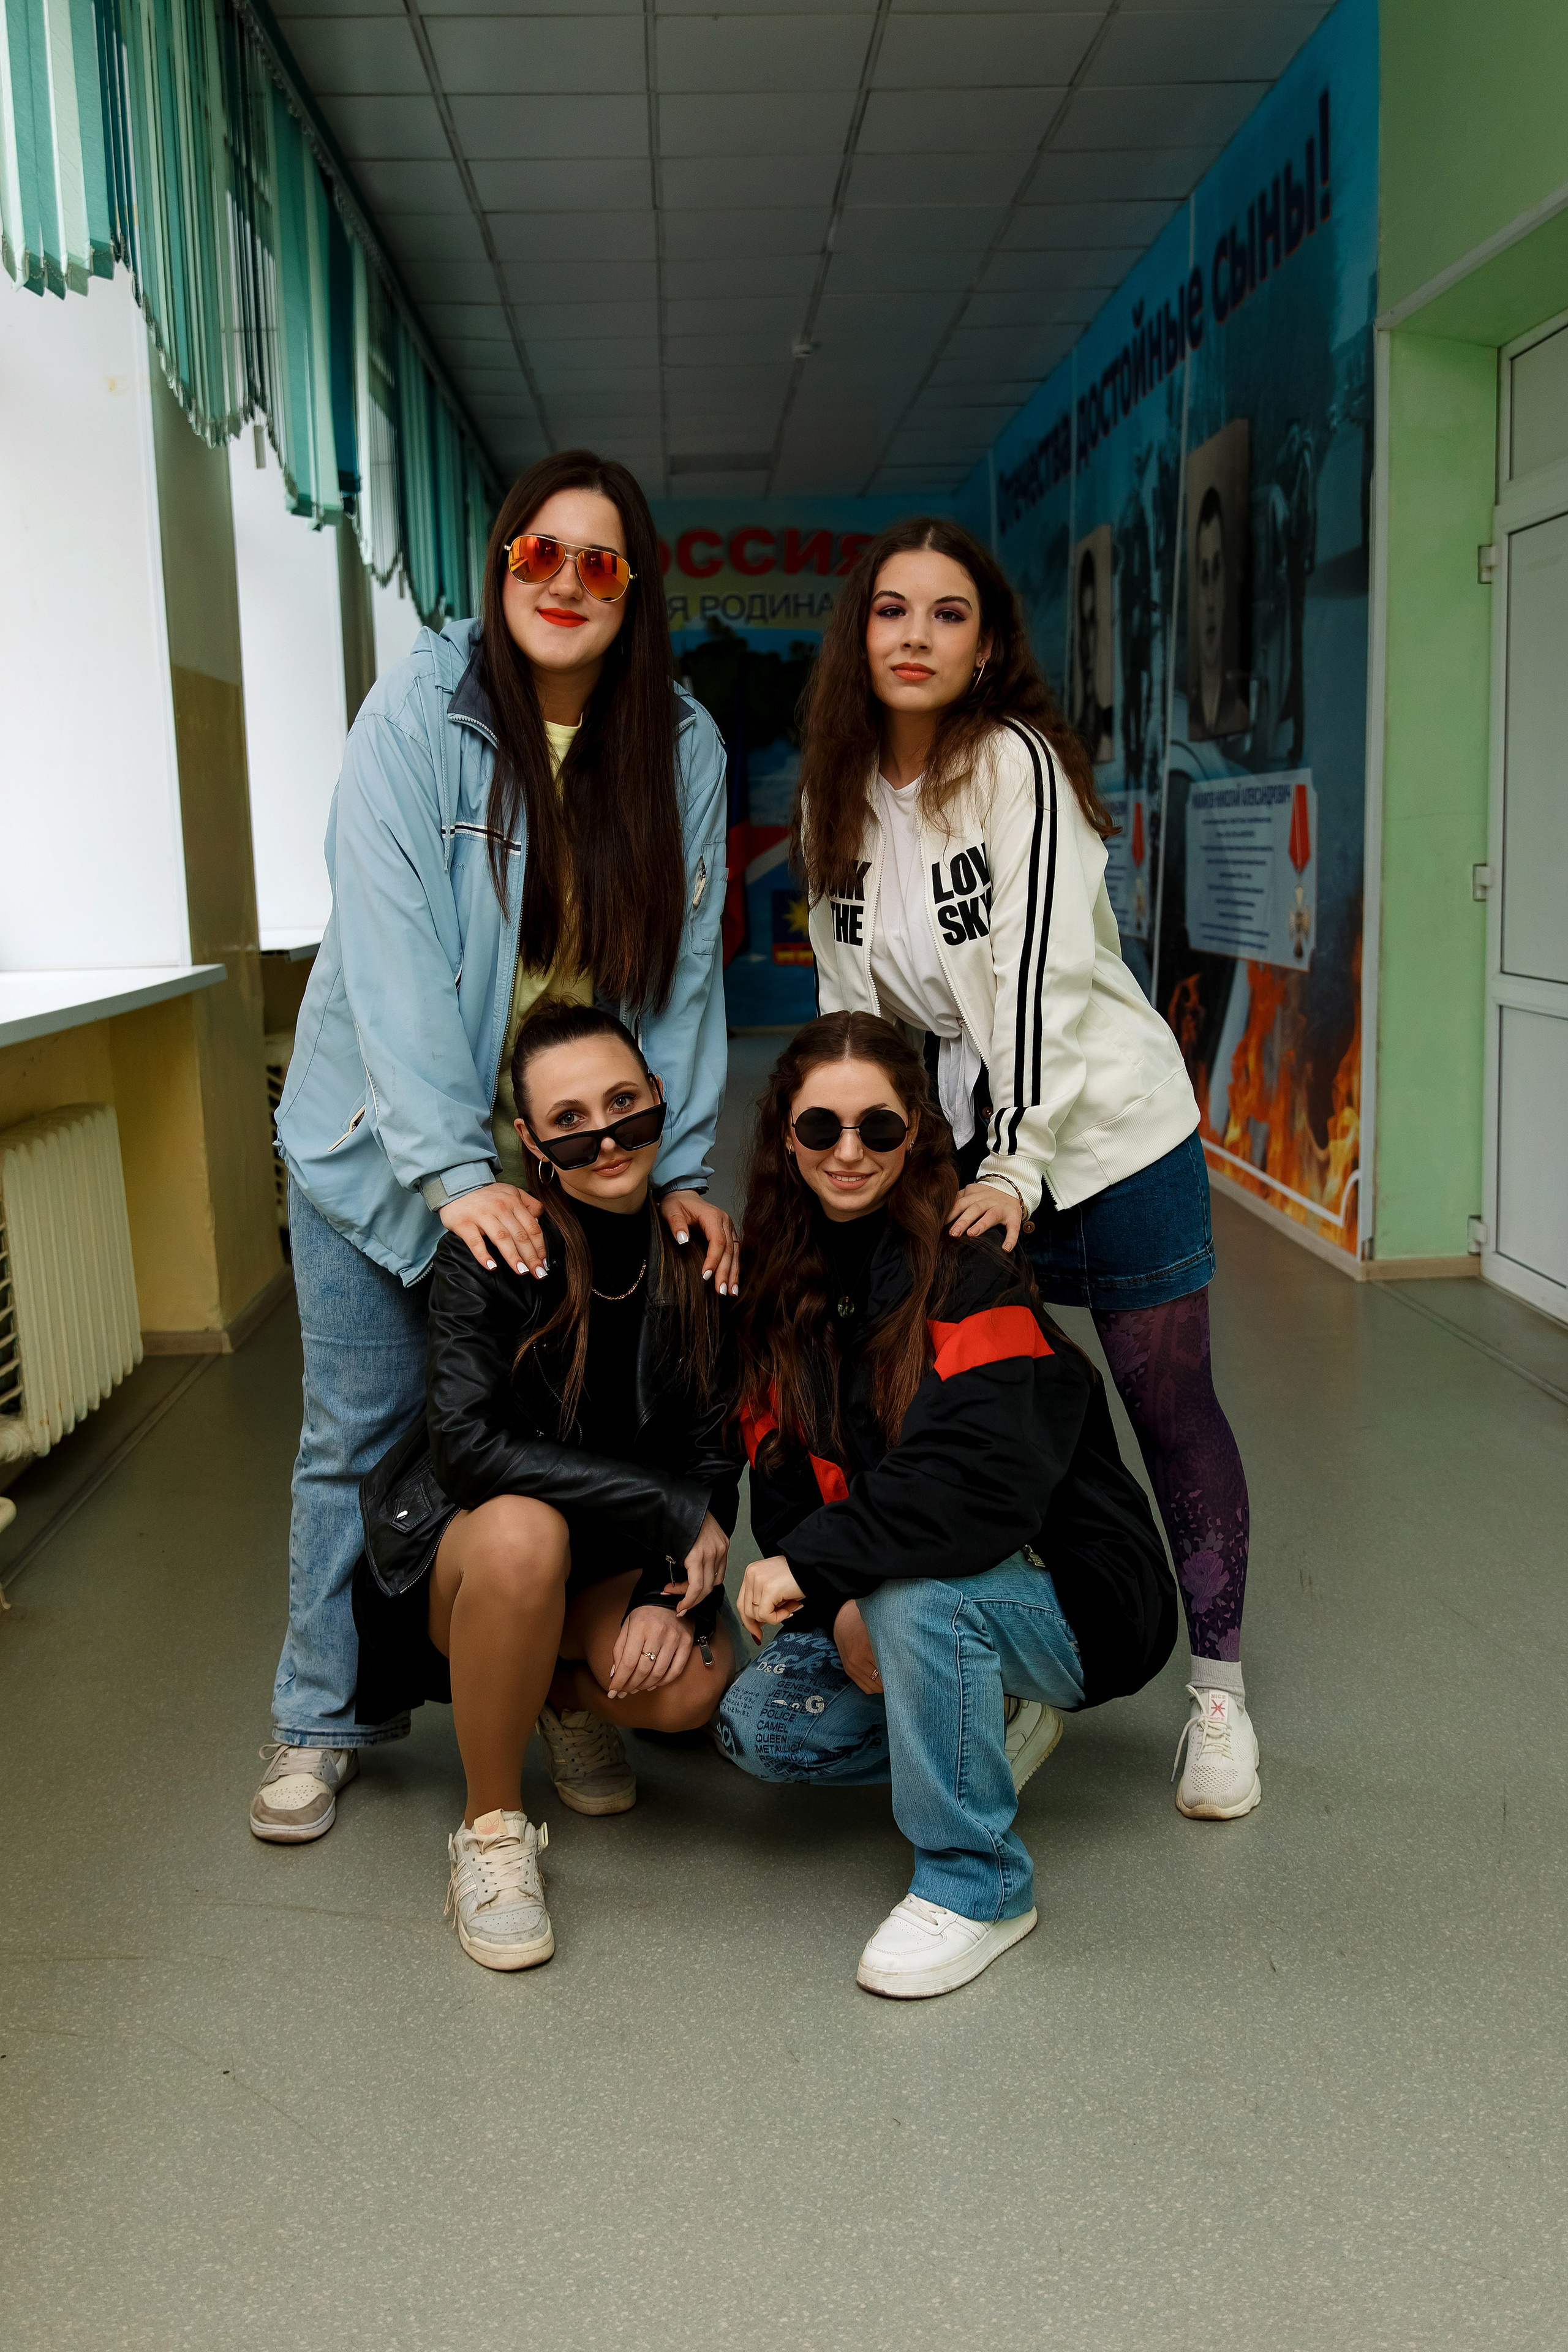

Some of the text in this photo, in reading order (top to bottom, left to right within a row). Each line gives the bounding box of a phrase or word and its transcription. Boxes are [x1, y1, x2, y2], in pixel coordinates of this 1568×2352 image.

[1077, 266, 1203, 475] достойные
[1212, 90, 1331, 324] сыны!
[659, 527, 878, 578] ССИЯ
[699, 592, 835, 626] РОДИНА
[829, 900, 864, 947] THE
[756, 1661, 786, 1675] D&G
[777, 1680, 821, 1695] GENESIS
[760, 1708, 796, 1722] POLICE
[757, 1721, 788, 1733] CAMEL
[755, 1733, 787, 1743] QUEEN
